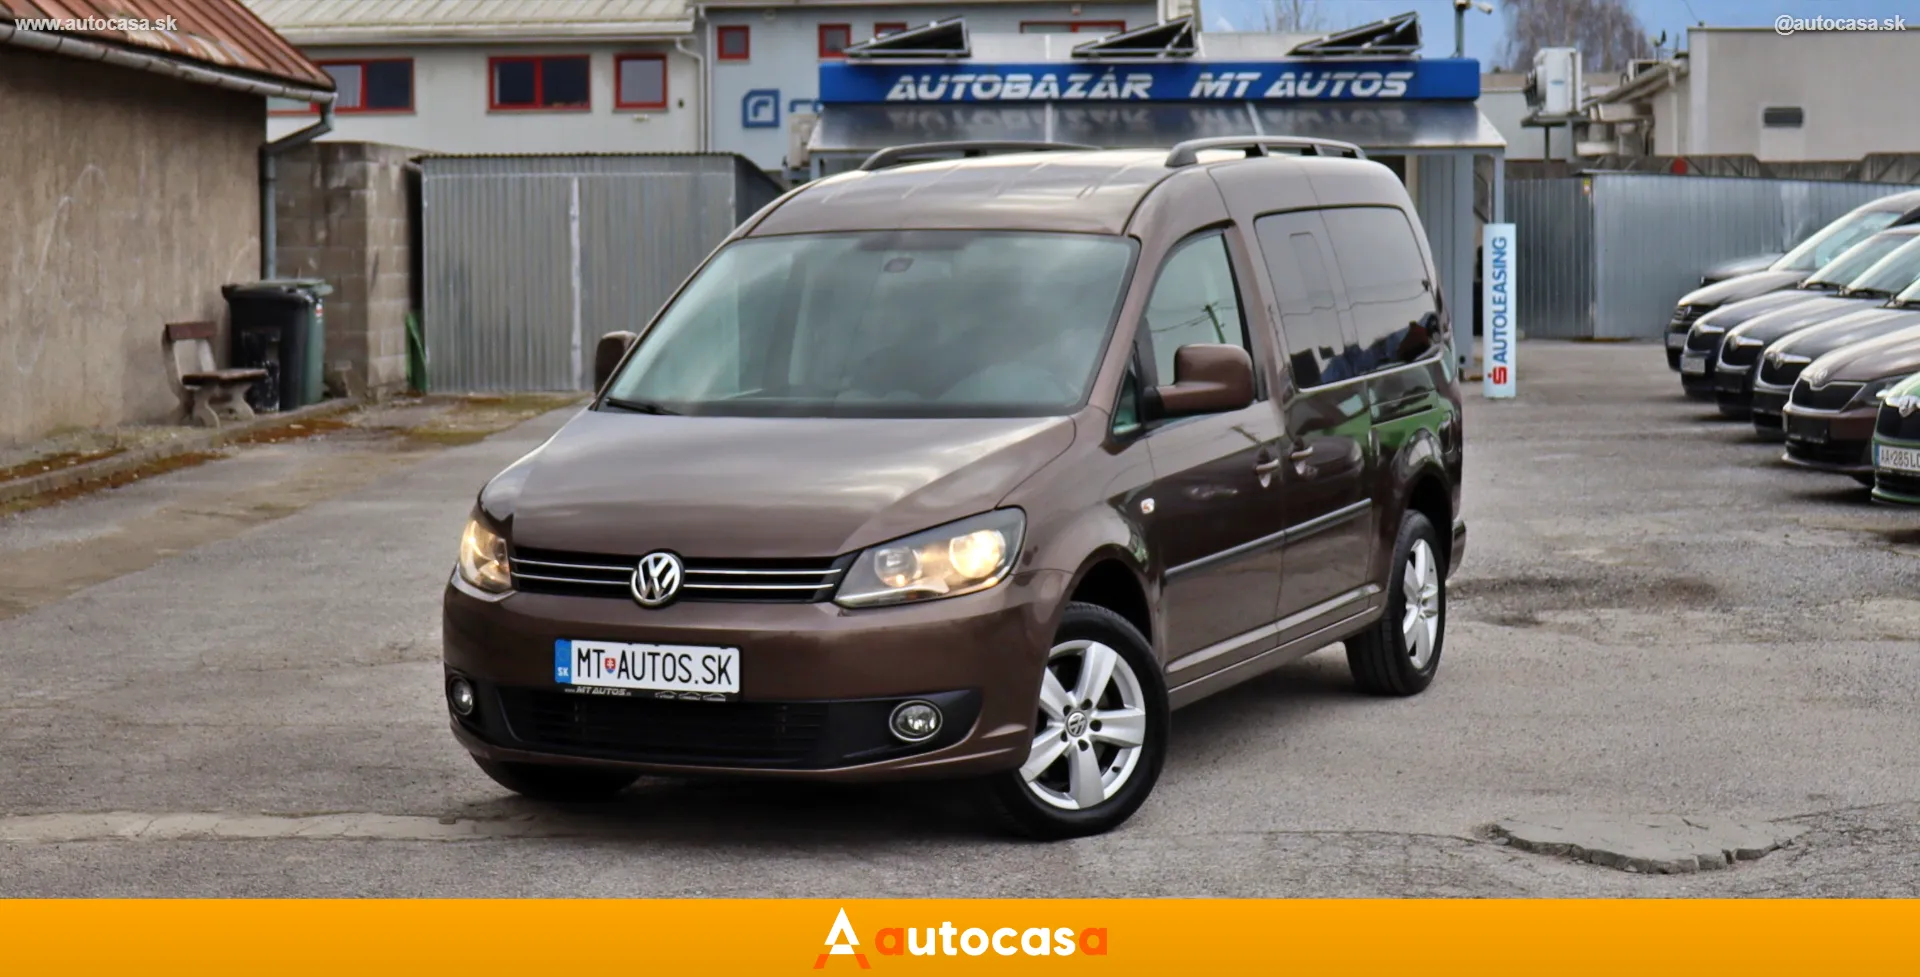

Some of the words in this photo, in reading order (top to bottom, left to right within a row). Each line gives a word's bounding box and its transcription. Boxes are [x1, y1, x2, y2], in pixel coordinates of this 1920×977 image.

[886, 66, 1153, 101] AUTOBAZÁR
[1190, 72, 1262, 98] MT
[1264, 71, 1414, 98] AUTOS
[1492, 236, 1508, 363] AUTOLEASING
[557, 666, 569, 677] SK
